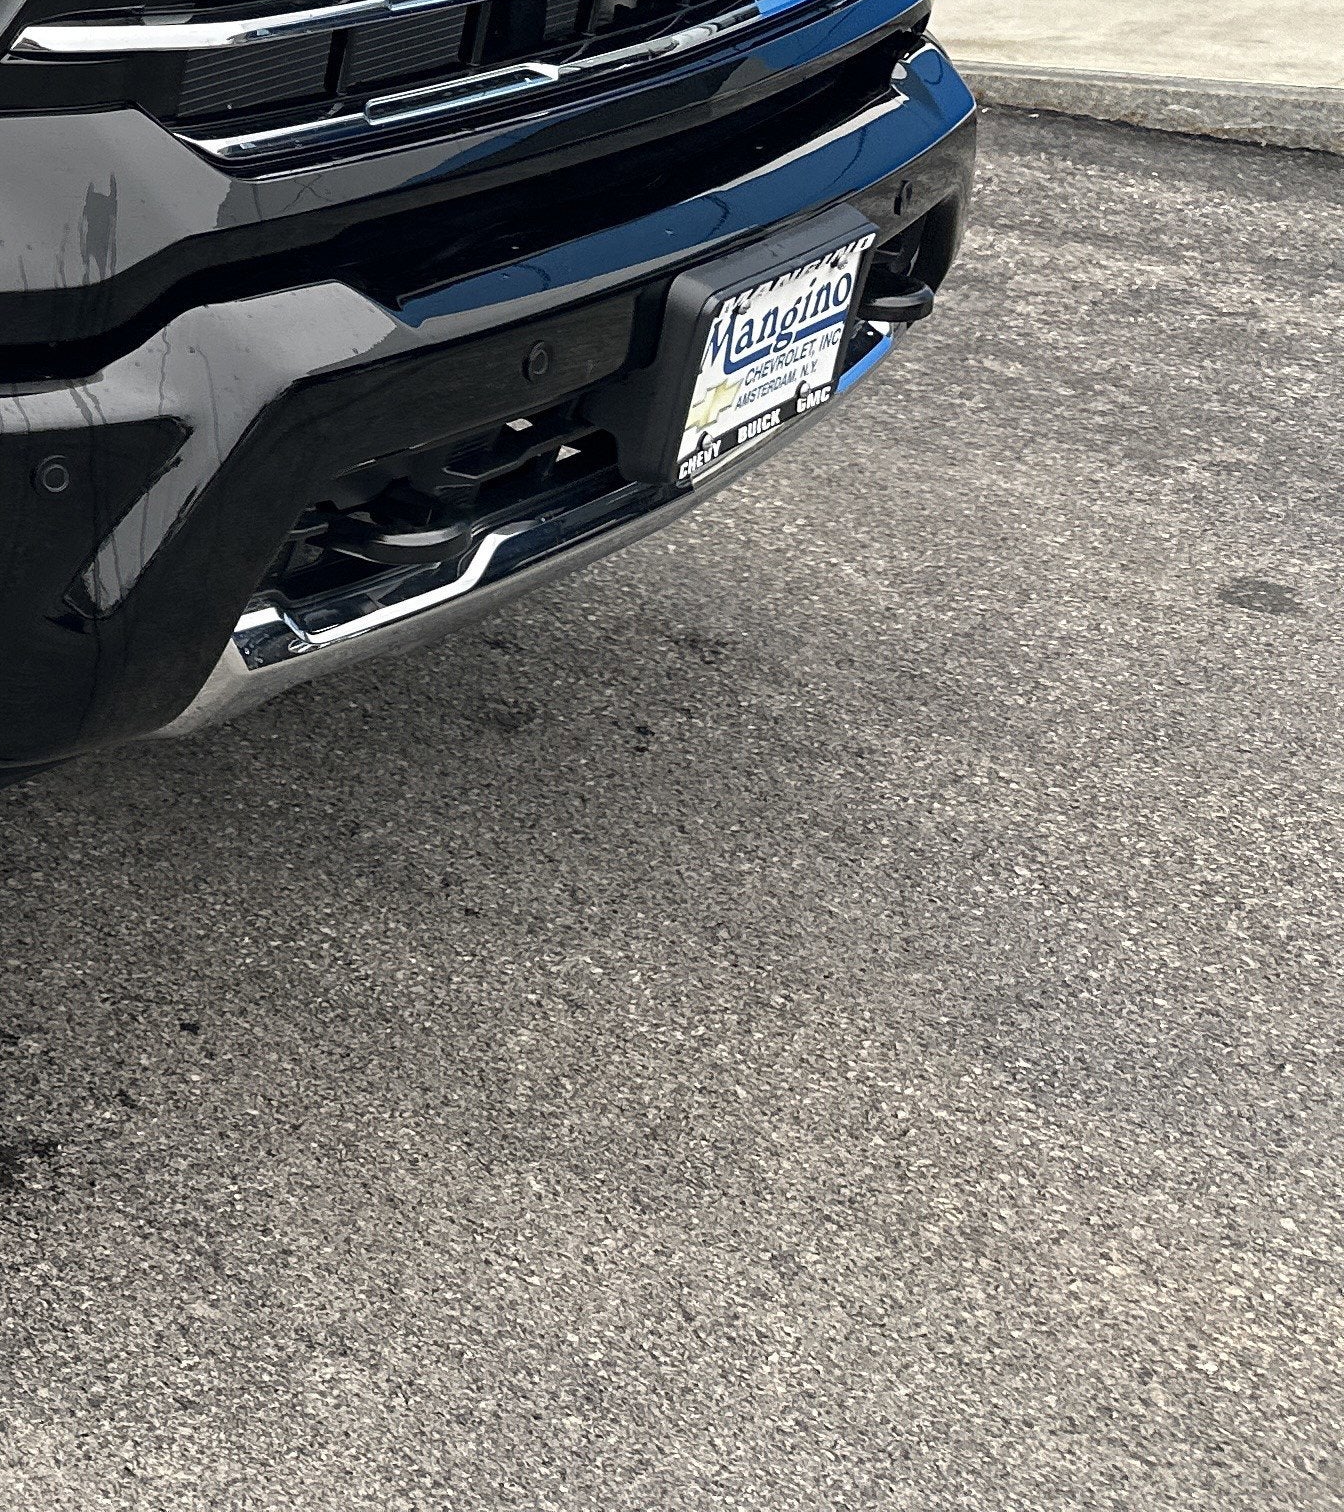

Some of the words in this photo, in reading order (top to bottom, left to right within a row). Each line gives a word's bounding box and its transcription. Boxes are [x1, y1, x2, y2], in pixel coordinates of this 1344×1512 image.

[710, 272, 852, 375] Mangino
[678, 440, 722, 480] CHEVY
[737, 408, 782, 444] BUICK
[796, 385, 832, 413] GMC
